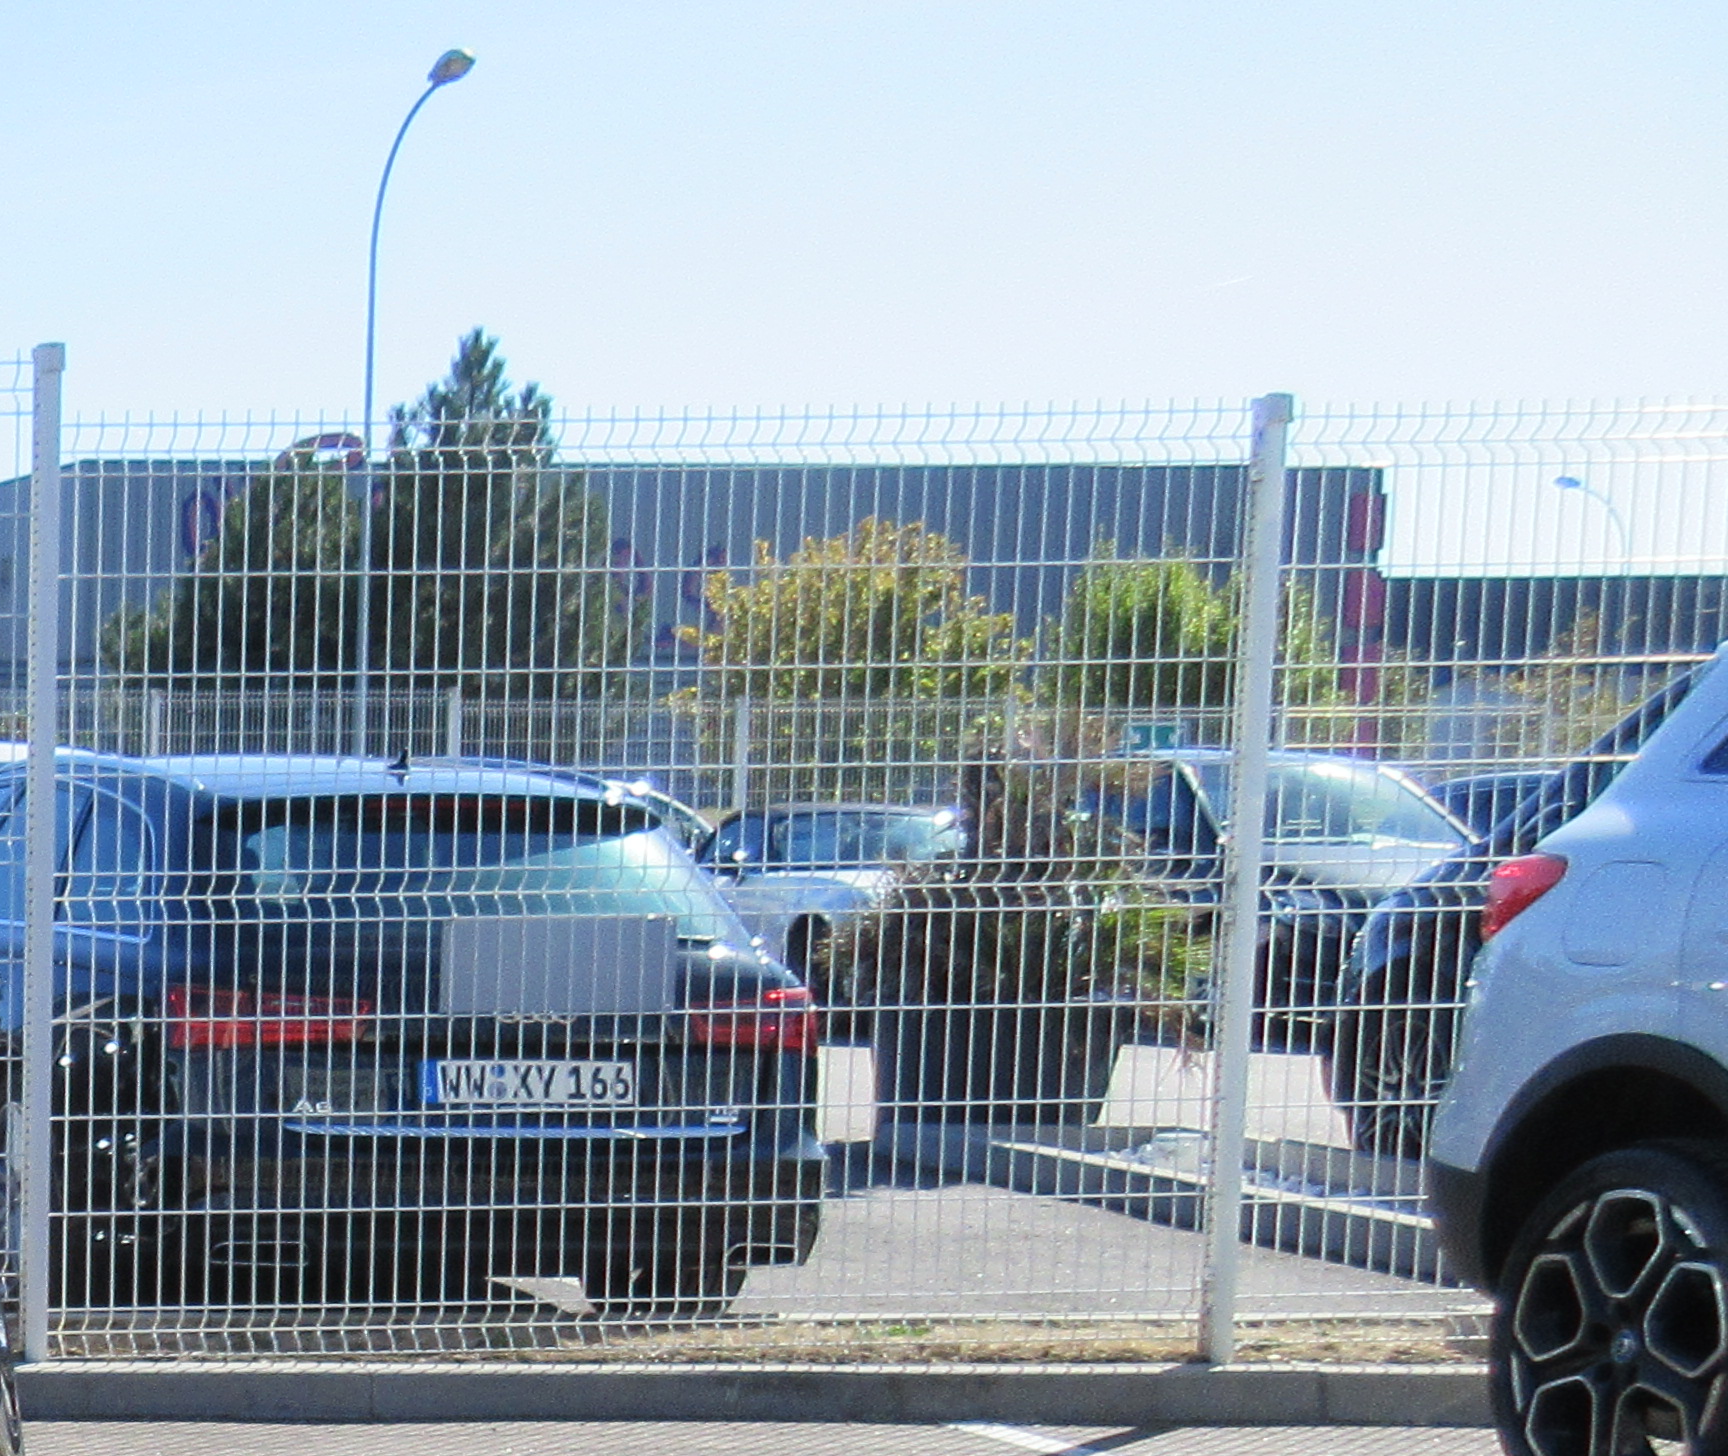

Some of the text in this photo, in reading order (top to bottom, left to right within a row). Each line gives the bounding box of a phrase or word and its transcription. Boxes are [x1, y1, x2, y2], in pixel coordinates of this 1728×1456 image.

[441, 1064, 630, 1100] WW XY 166
